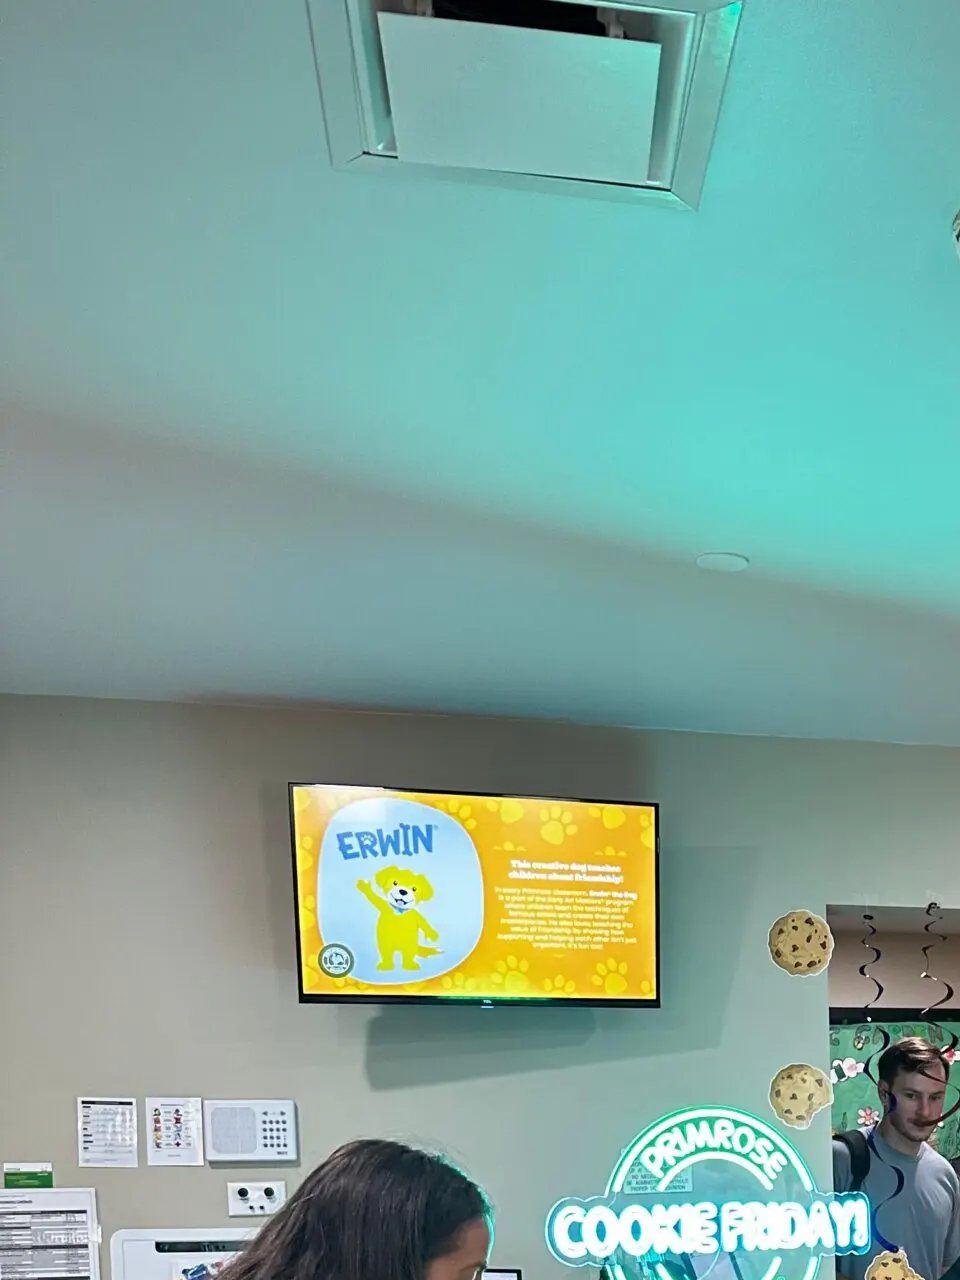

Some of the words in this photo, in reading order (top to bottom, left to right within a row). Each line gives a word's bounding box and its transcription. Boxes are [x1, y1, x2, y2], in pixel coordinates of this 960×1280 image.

[336, 823, 434, 860] ERWIN
[640, 1118, 788, 1180] PRIMROSE
[553, 1202, 718, 1258] COOKIE
[719, 1200, 869, 1252] FRIDAY!
